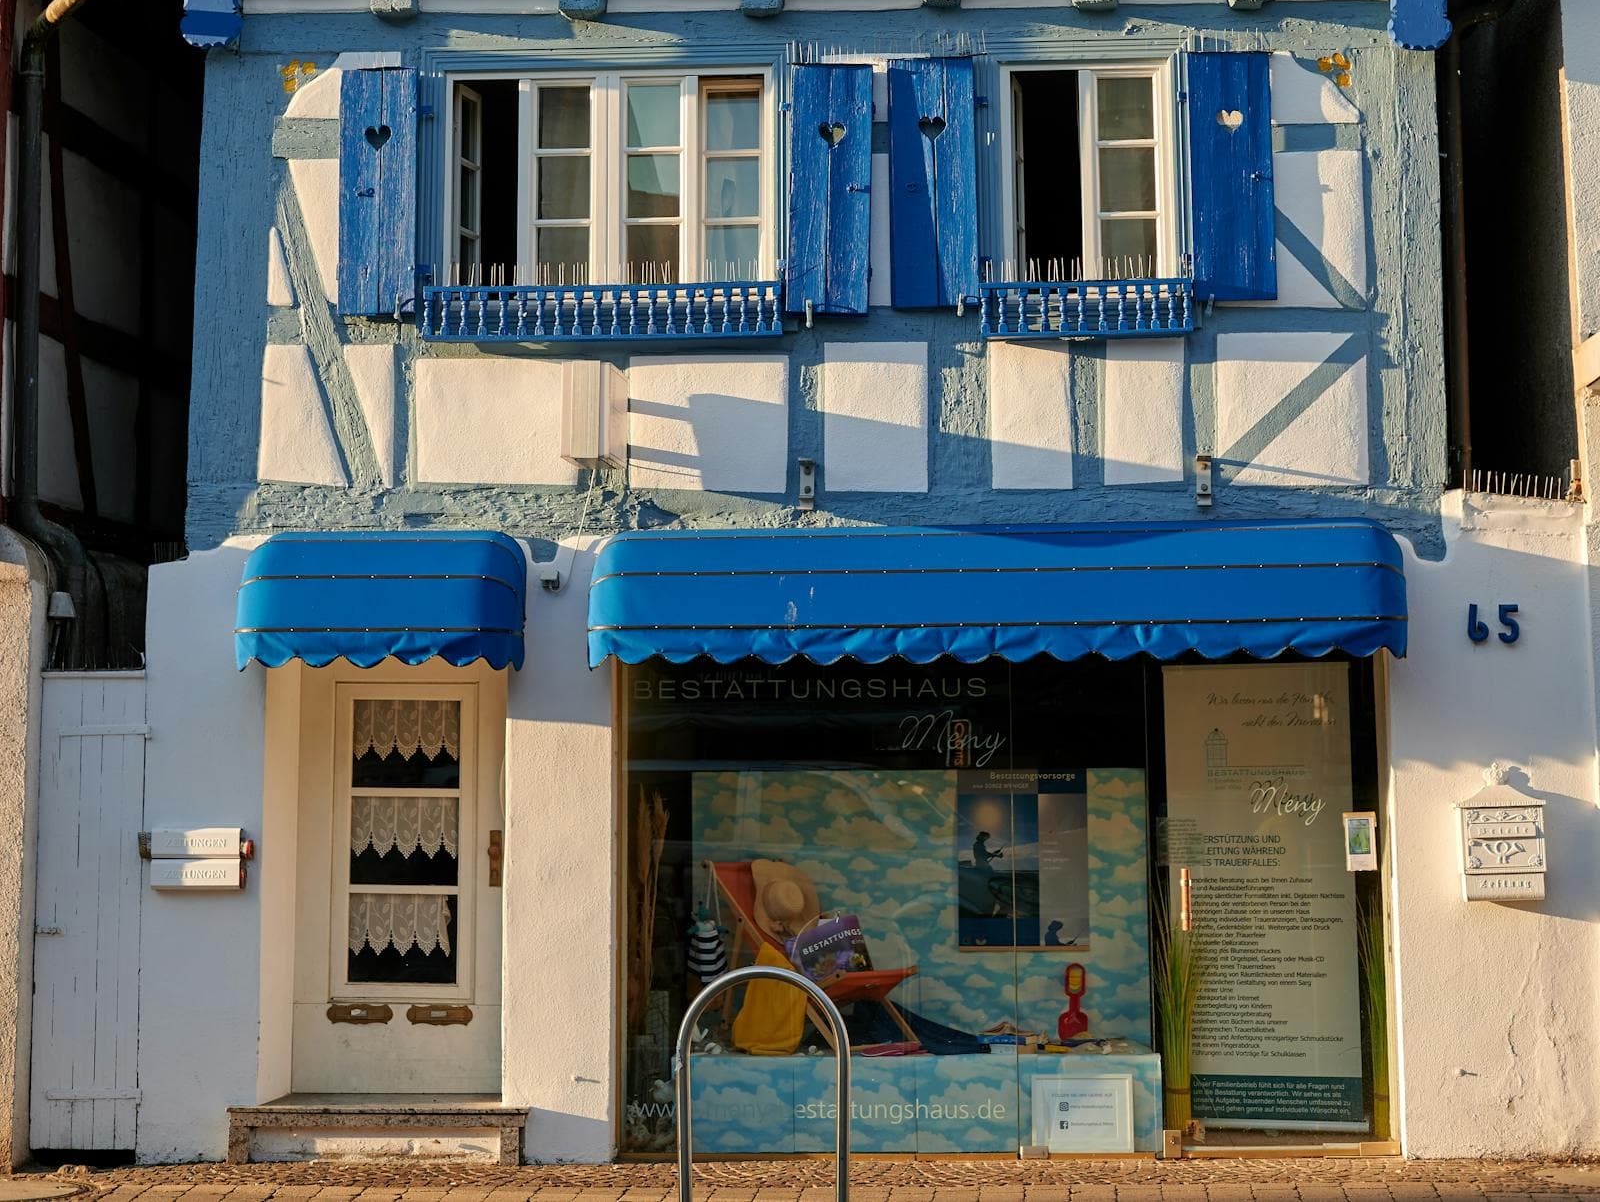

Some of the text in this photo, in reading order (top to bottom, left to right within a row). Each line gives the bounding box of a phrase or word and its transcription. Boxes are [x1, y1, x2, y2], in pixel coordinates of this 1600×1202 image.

[1468, 604, 1519, 644] 65
[634, 677, 987, 700] BESTATTUNGSHAUS
[899, 709, 1007, 767] Meny
[990, 771, 1076, 782] Bestattungsvorsorge
[1250, 782, 1327, 826] Meny
[164, 837, 228, 848] ZEITUNGEN
[1203, 833, 1281, 844] ERSTÜTZUNG UND
[1205, 845, 1286, 855] EITUNG WÄHREND
[1213, 858, 1281, 867] TRAUERFALLES:
[163, 869, 227, 880] ZEITUNGEN
[802, 928, 862, 955] BESTATTUNGS
[634, 1098, 1006, 1124] wwmenyestatungshaus.de
